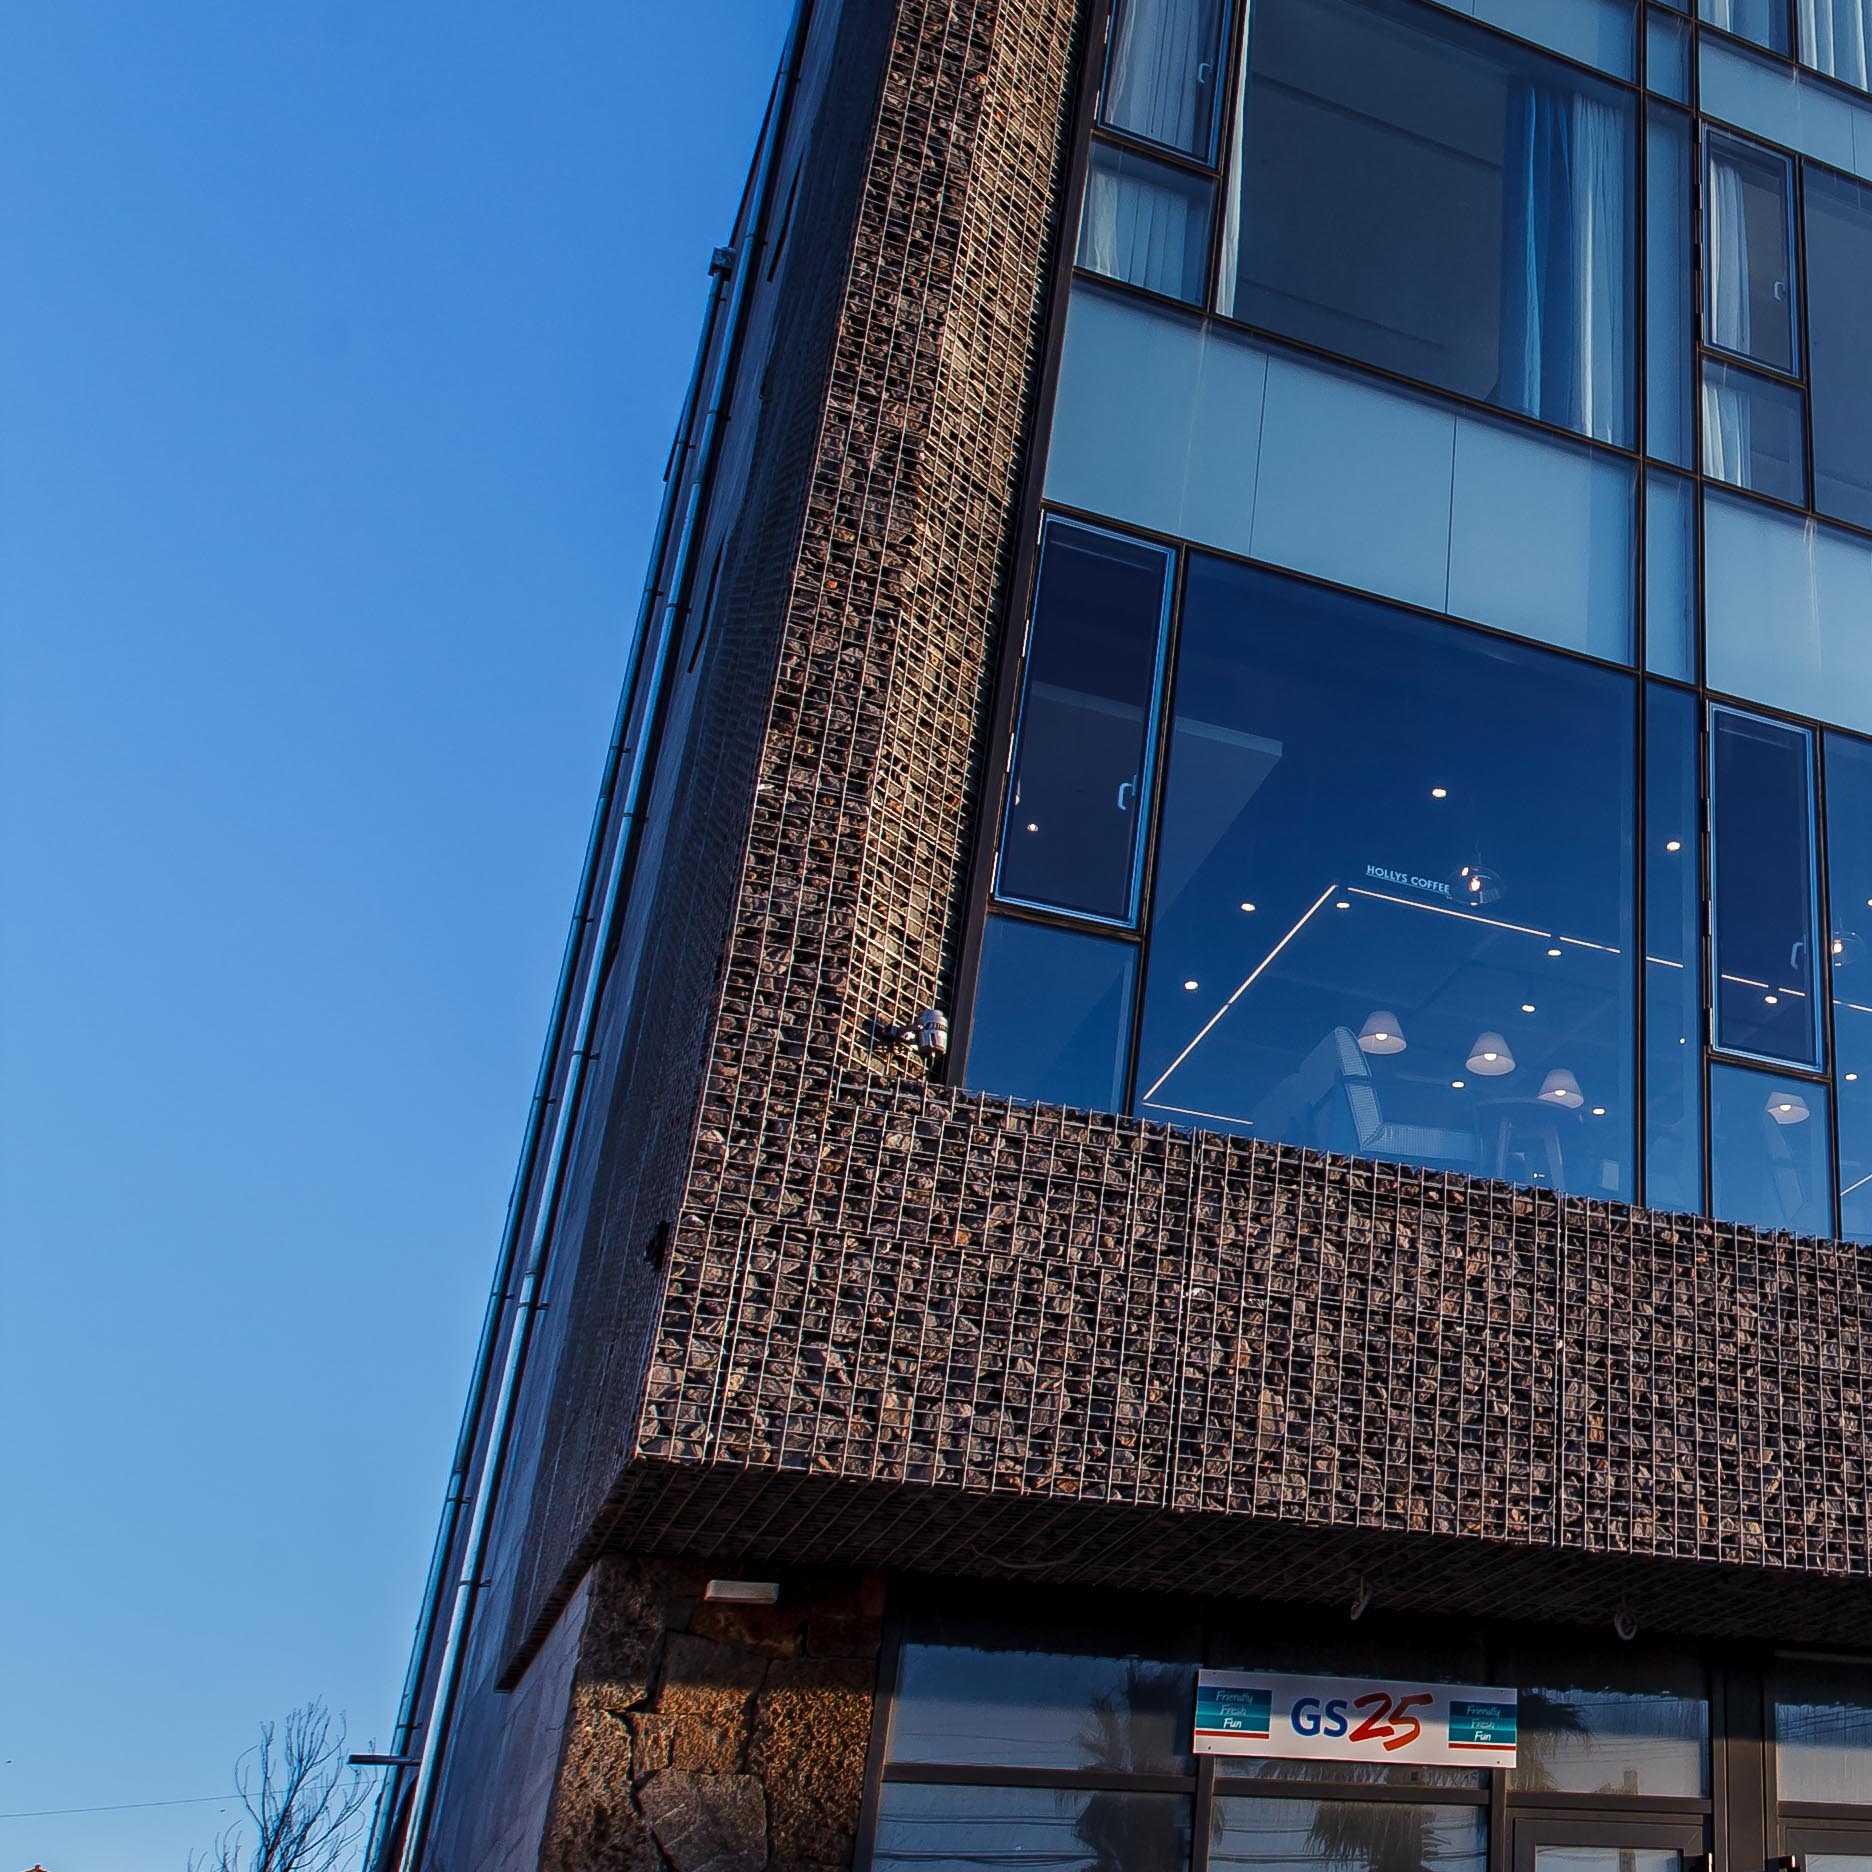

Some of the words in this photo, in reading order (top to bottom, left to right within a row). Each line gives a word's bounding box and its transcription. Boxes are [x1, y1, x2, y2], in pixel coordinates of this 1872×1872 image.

[1366, 864, 1408, 884] HOLLYS
[1410, 876, 1451, 894] COFFEE
[1216, 1690, 1254, 1705] Friendly
[1219, 1704, 1247, 1716] Fresh
[1466, 1704, 1501, 1719] Friendly
[1223, 1717, 1243, 1729] Fun
[1470, 1718, 1496, 1729] Fresh
[1474, 1730, 1492, 1742] Fun
